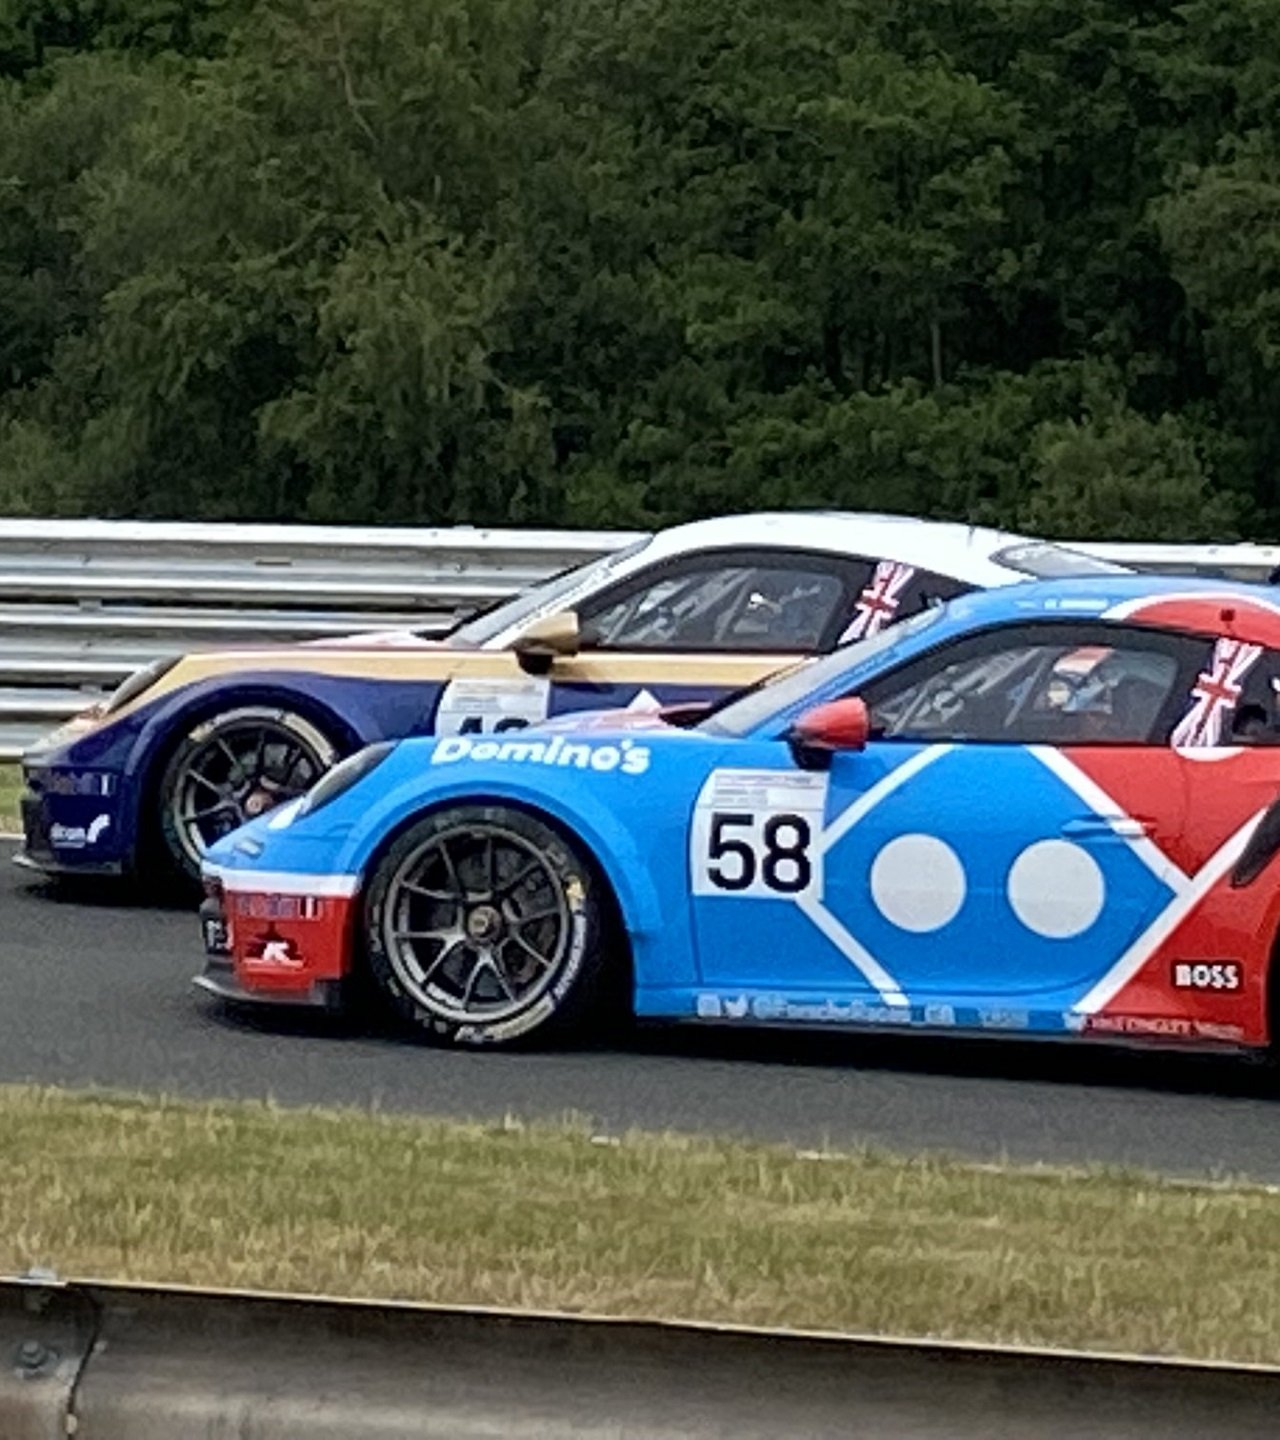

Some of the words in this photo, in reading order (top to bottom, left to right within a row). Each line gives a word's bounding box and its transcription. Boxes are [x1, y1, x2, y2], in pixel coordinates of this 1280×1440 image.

[431, 736, 651, 775] Domino's
[707, 812, 811, 894] 58
[1176, 964, 1239, 989] BOSS
